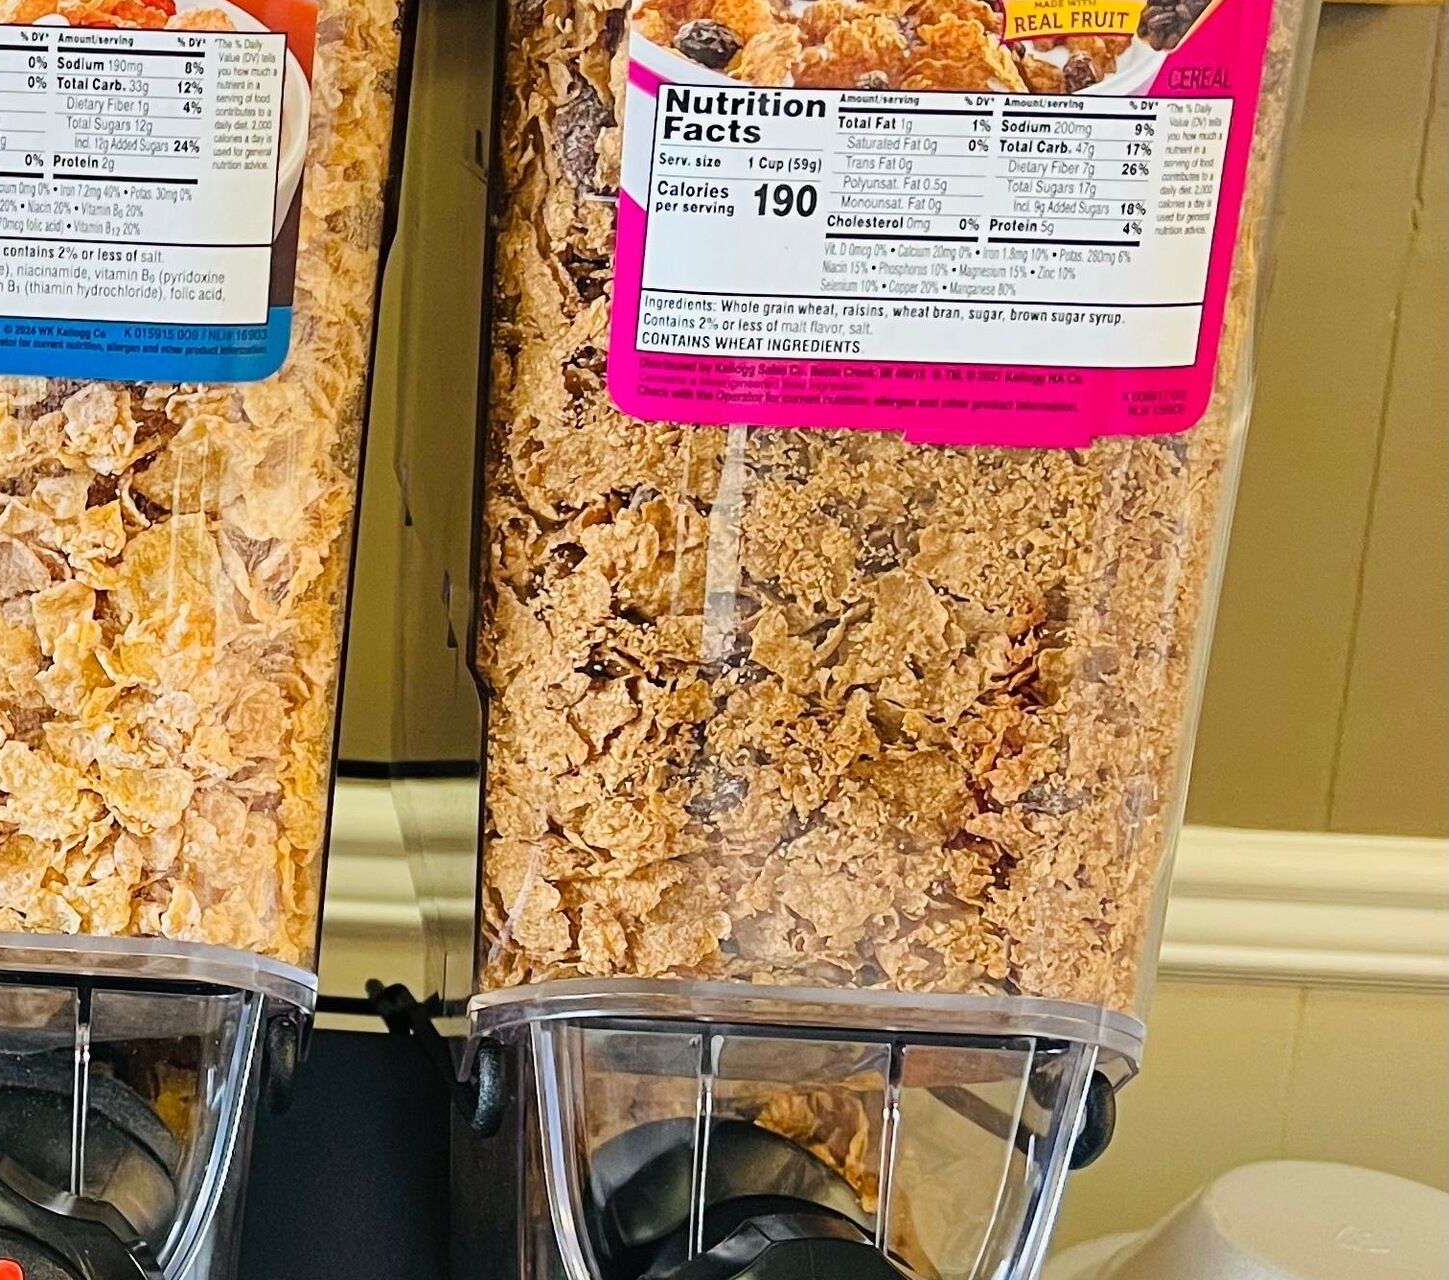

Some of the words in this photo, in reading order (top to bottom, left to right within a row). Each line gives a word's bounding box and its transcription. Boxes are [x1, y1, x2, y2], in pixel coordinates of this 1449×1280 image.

[1067, 0, 1097, 8] WITH
[1014, 13, 1063, 34] REAL
[1071, 11, 1130, 30] FRUIT
[28, 56, 48, 70] 0%
[57, 57, 104, 72] Sodium
[57, 76, 89, 90] Total
[92, 78, 127, 91] Carb.
[177, 81, 203, 94] 12%
[1168, 68, 1230, 90] CEREAL
[666, 88, 826, 118] Nutrition
[663, 115, 761, 144] Facts
[838, 116, 871, 130] Total
[875, 117, 896, 130] Fat
[972, 119, 991, 133] 1%
[1001, 119, 1051, 134] Sodium
[1135, 122, 1155, 137] 9%
[174, 139, 200, 153] 24%
[1000, 139, 1032, 153] Total
[1037, 140, 1072, 154] Carb.
[1126, 143, 1152, 156] 17%
[25, 153, 44, 167] 0%
[53, 155, 99, 169] Protein
[658, 152, 691, 167] Serv.
[695, 154, 721, 168] size
[759, 156, 784, 171] Cup
[788, 157, 822, 173] (59g)
[657, 180, 729, 199] Calories
[655, 201, 678, 213] per
[682, 200, 735, 217] serving
[754, 182, 818, 218] 190
[827, 214, 903, 229] Cholesterol
[959, 218, 980, 231] 0%
[989, 218, 1038, 233] Protein
[1123, 221, 1142, 235] 4%
[2, 245, 55, 260] contains
[58, 247, 78, 261] 2%
[81, 249, 93, 261] or
[97, 248, 123, 262] less
[126, 249, 138, 262] of
[645, 295, 717, 312] Ingredients:
[721, 299, 760, 314] Whole
[763, 300, 795, 316] grain
[798, 302, 839, 317] wheat,
[842, 304, 888, 318] raisins,
[892, 305, 930, 318] wheat
[933, 306, 964, 320] bran,
[968, 309, 1005, 322] sugar,
[1010, 308, 1048, 322] brown
[1051, 312, 1085, 324] sugar
[1089, 313, 1126, 326] syrup.
[642, 332, 711, 349] CONTAINS
[715, 336, 763, 351] WHEAT
[767, 338, 865, 354] INGREDIENTS.
